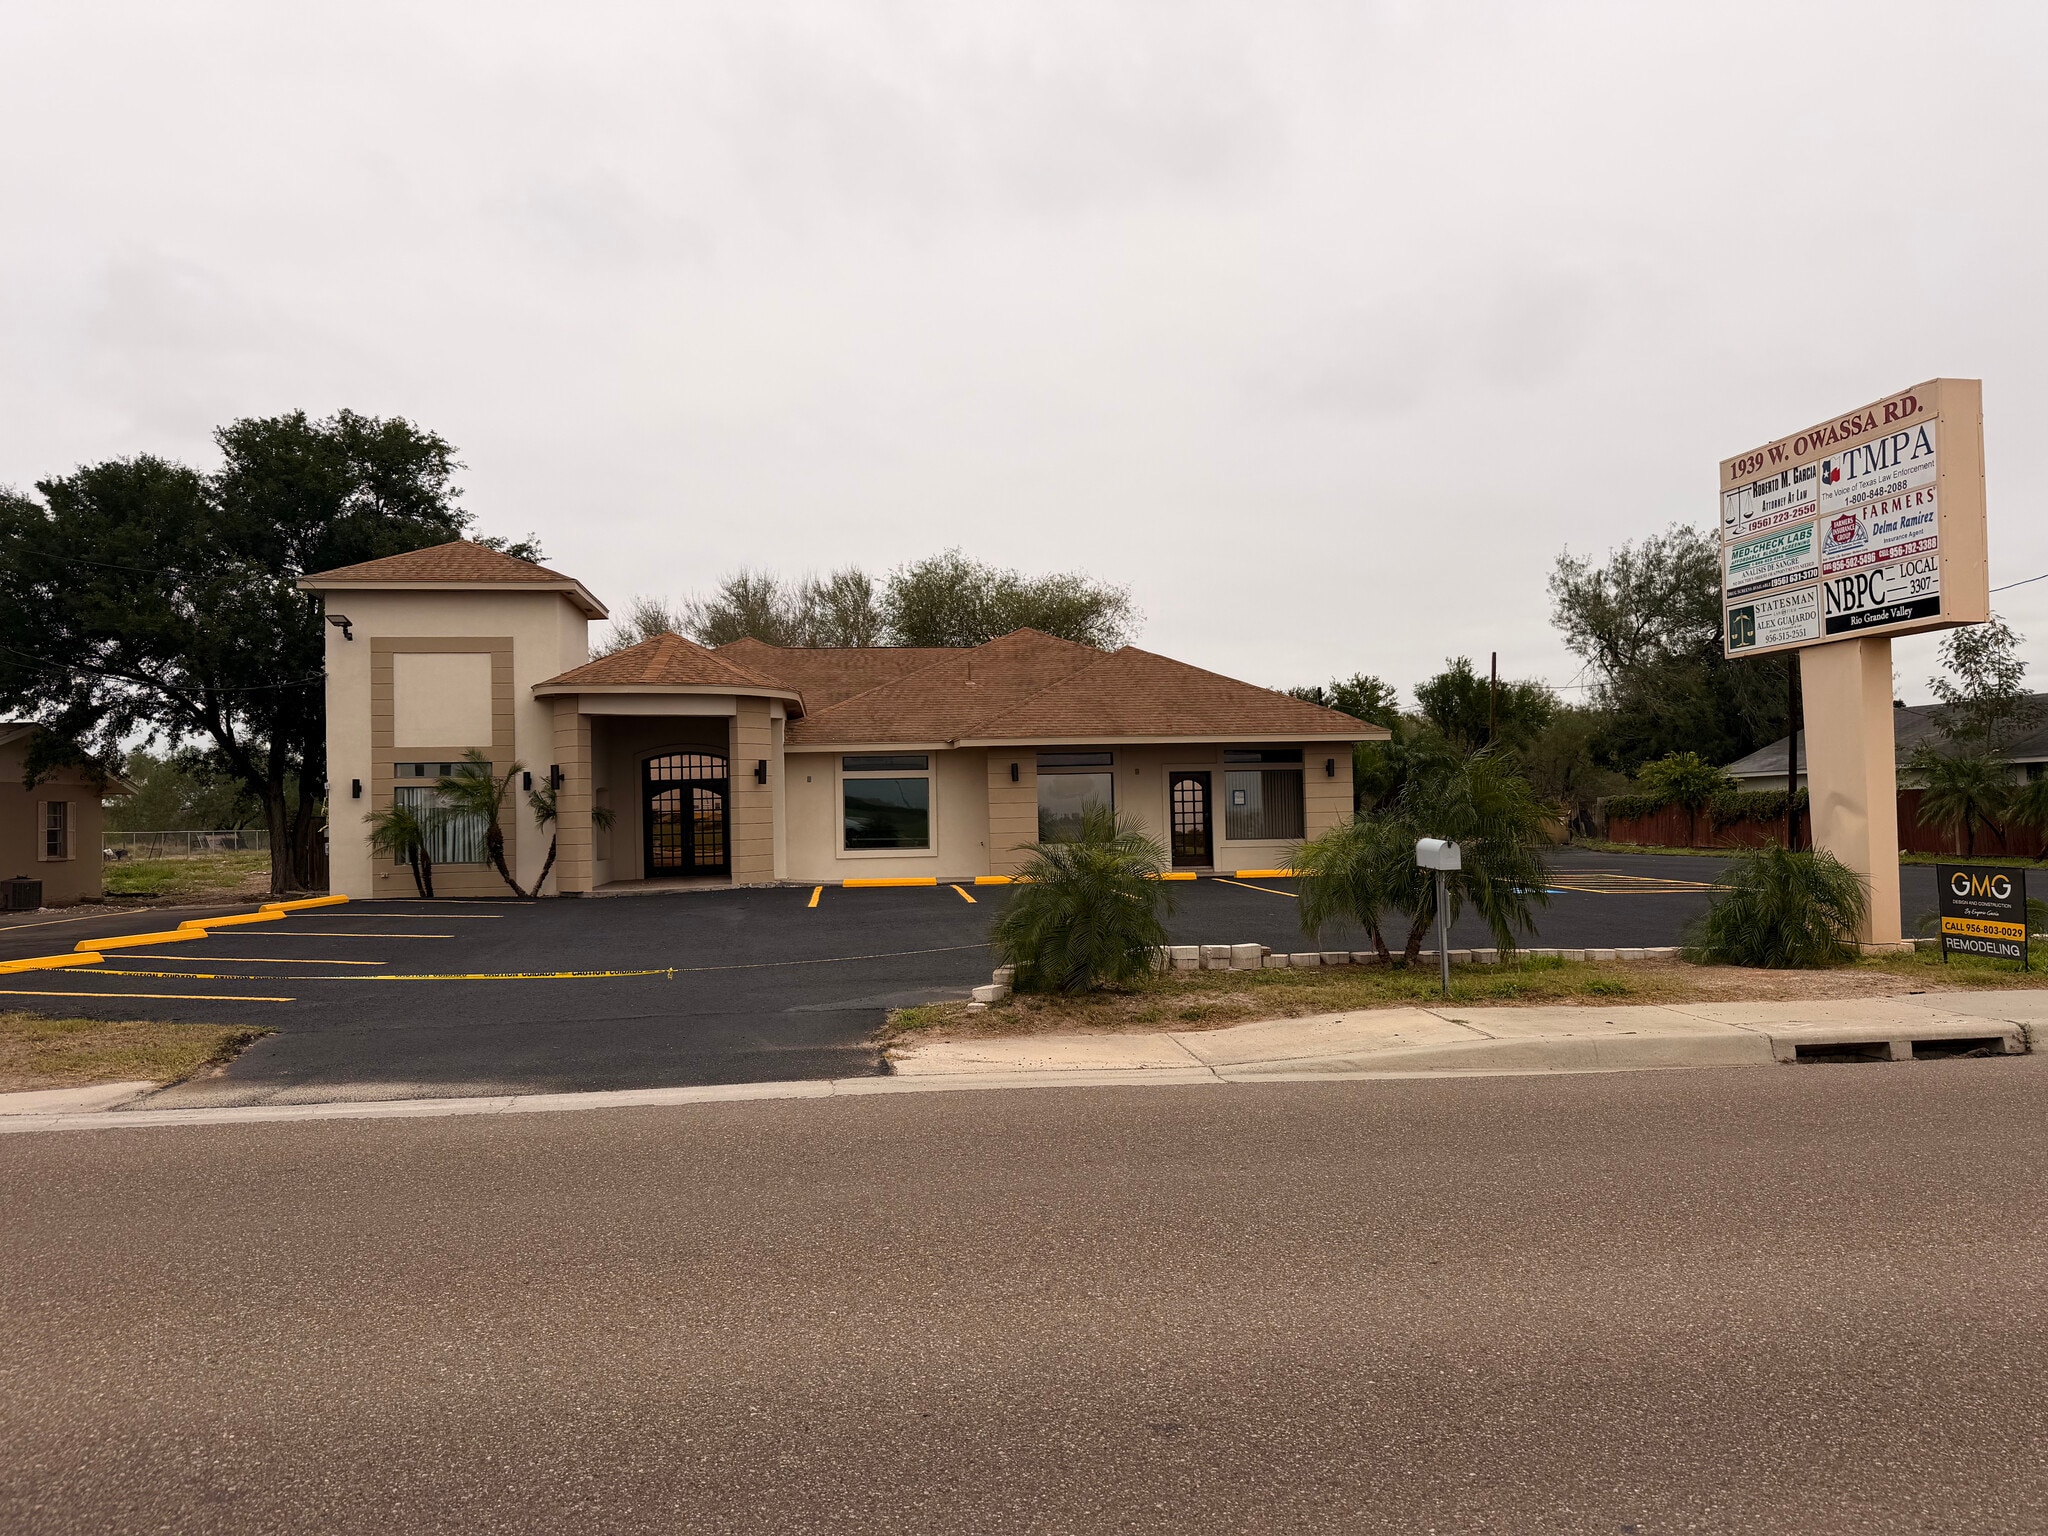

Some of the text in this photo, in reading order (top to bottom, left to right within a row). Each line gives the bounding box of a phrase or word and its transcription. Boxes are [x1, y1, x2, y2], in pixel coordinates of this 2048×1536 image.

[1731, 395, 1923, 480] 1939 W. OWASSA RD.
[1843, 425, 1934, 480] TMPA
[1753, 465, 1816, 498] ROBERTO M. GARCIA
[1822, 460, 1934, 501] The Voice of Texas Law Enforcement
[1762, 497, 1786, 512] ATTORNEY
[1796, 489, 1807, 501] LAW
[1845, 480, 1908, 506] 1-800-848-2088
[1862, 488, 1934, 520] FARMERS
[1749, 503, 1816, 531] (956) 223-2550
[1873, 511, 1934, 536] Delma Ramirez
[1731, 529, 1812, 560] MED-CHECK LABS
[1884, 529, 1924, 543] Insurance Agent
[1742, 566, 1767, 578] ANALISIS
[1776, 557, 1799, 569] SANGRE
[1832, 552, 1876, 571] 956-502-5496
[1824, 557, 1938, 615] NBPC LOCAL
[1910, 576, 1931, 594] 3307
[1755, 592, 1814, 614] STATESMAN
[1757, 619, 1776, 630] ALEX
[1778, 611, 1816, 627] GUAJARDO
[1851, 606, 1913, 625] Rio Grande Valley
[1765, 628, 1807, 643] 956-515-2551
[1951, 872, 2011, 899] GMG
[1978, 901, 2011, 909] CONSTRUCTION
[1945, 922, 2023, 937] CALL 956-803-0029
[1946, 937, 2020, 957] REMODELING
